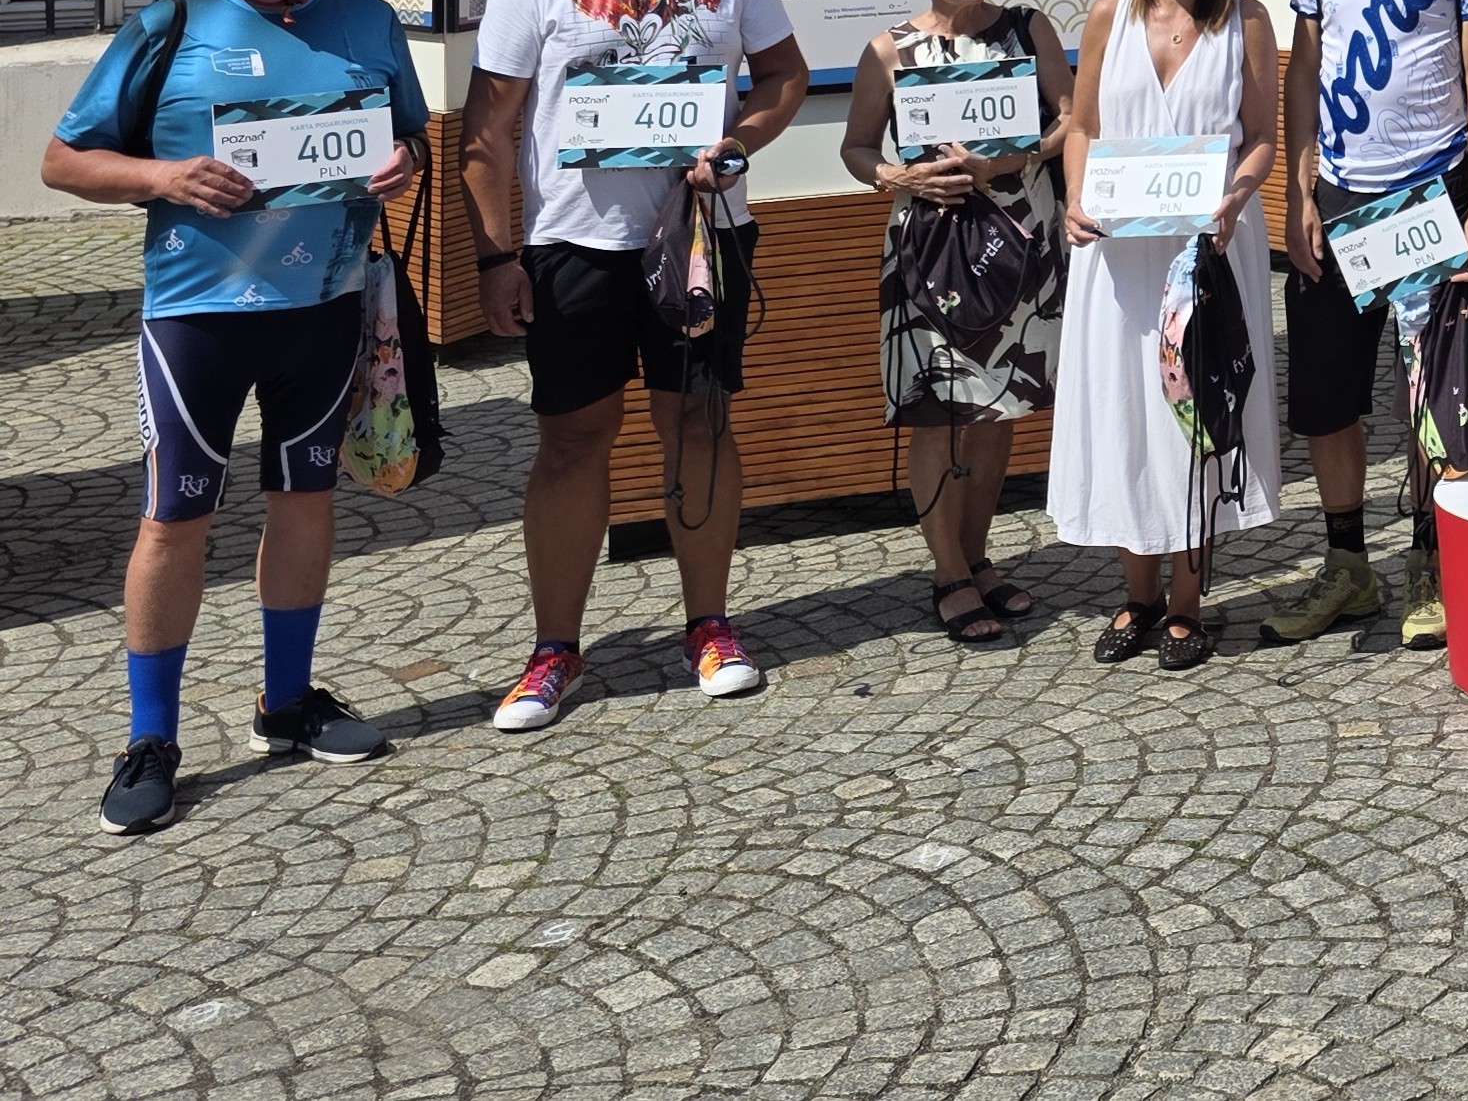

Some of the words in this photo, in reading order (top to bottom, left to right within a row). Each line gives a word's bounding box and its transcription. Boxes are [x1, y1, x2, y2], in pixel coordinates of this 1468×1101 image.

[635, 102, 698, 129] 400
[961, 95, 1016, 123] 400
[652, 134, 677, 143] PLN
[979, 126, 1001, 136] PLN
[298, 129, 366, 163] 400
[319, 165, 347, 178] PLN
[1145, 171, 1202, 199] 400
[1160, 202, 1182, 213] PLN
[1394, 219, 1442, 257] 400
[1415, 254, 1436, 268] PLN
[308, 446, 335, 467] R&P
[178, 474, 209, 498] R&P
